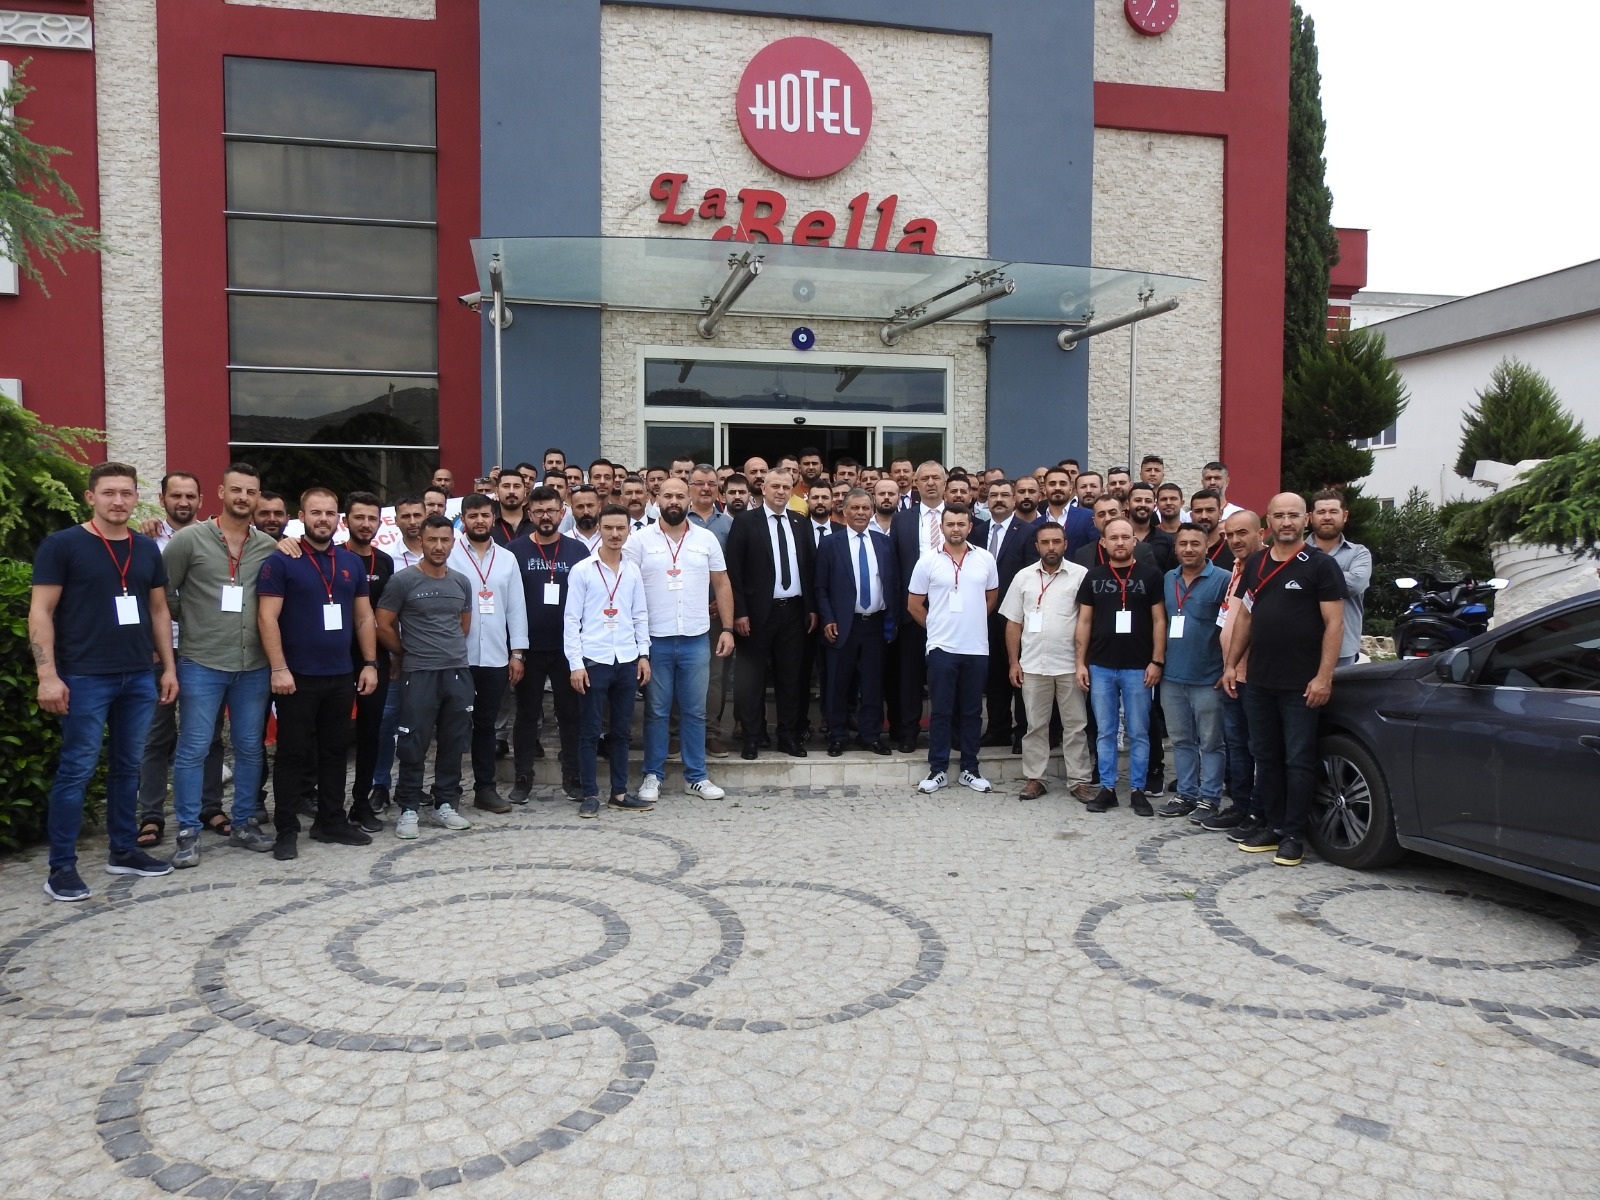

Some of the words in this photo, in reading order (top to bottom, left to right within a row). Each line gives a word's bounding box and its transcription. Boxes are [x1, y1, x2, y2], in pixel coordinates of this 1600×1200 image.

[748, 70, 860, 135] HOTEL
[650, 172, 728, 226] La
[711, 188, 938, 255] Bella
[1091, 579, 1146, 594] USPA
